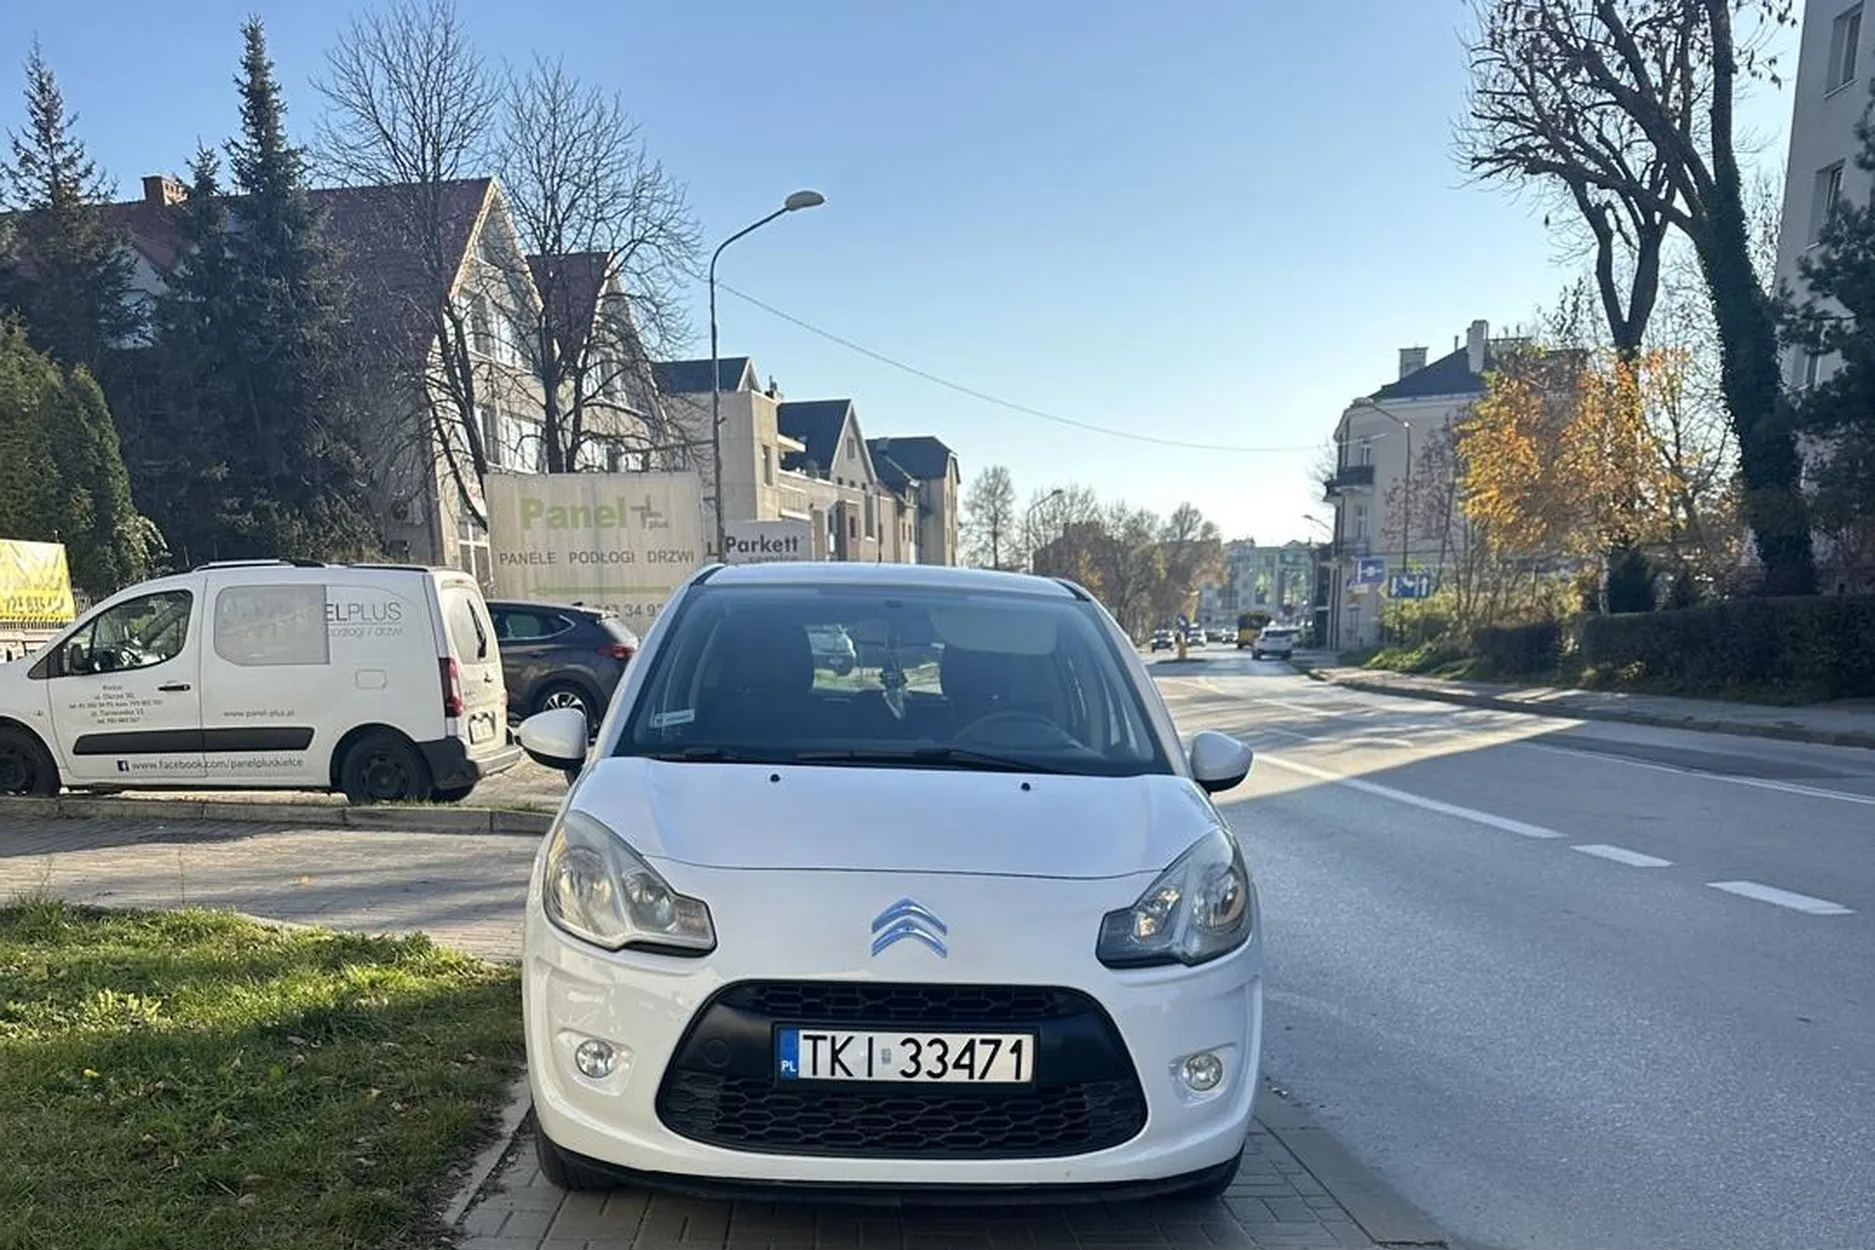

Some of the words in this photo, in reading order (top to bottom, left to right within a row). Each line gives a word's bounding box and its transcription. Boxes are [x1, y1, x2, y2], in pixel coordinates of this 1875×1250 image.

[520, 497, 627, 529] Panel
[726, 533, 798, 553] Parkett
[499, 551, 556, 565] PANELE
[568, 550, 635, 565] PODŁOGI
[647, 550, 695, 564] DRZWI
[624, 603, 642, 617] 34
[803, 1034, 874, 1078] TKI
[900, 1037, 1023, 1080] 33471
[781, 1060, 797, 1072] PL
